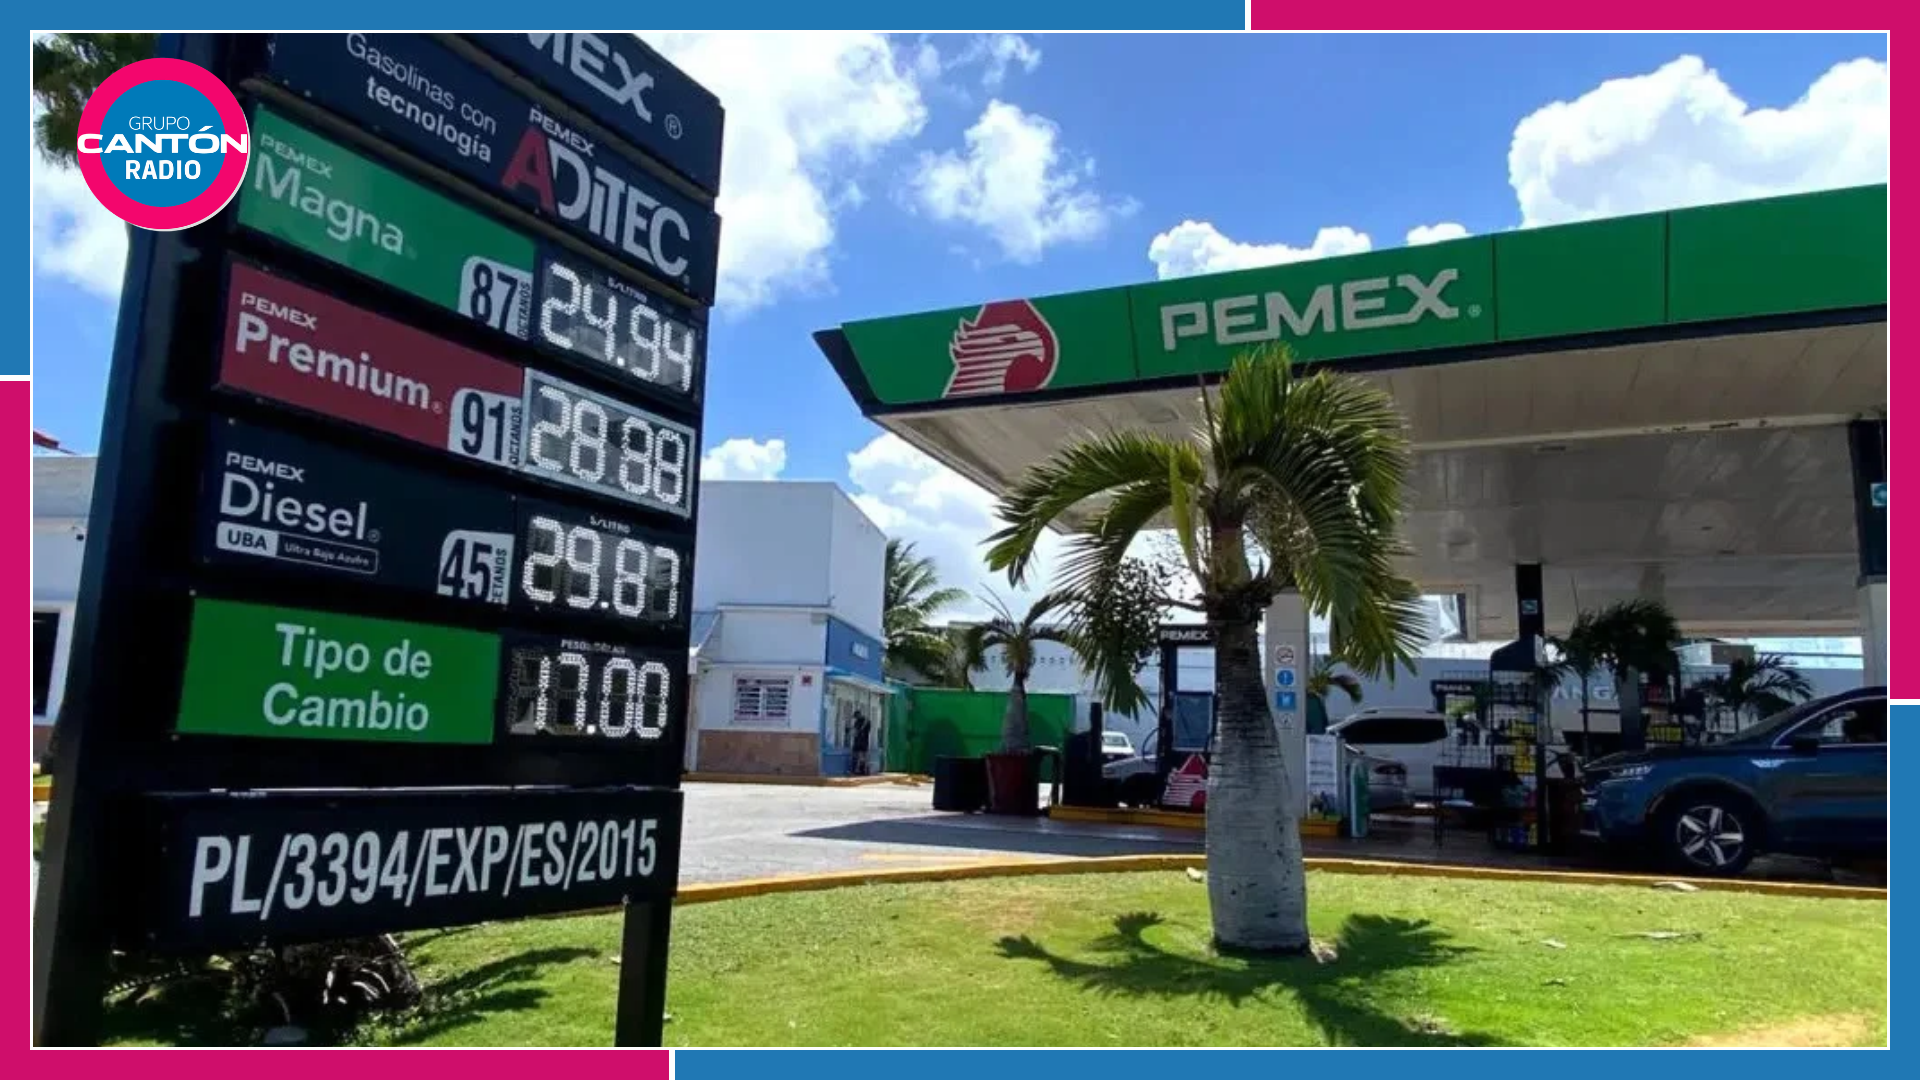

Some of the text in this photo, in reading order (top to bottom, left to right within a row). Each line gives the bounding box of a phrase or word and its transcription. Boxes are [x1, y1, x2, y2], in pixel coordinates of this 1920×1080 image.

[346, 33, 497, 136] Gasolinas con
[260, 133, 334, 179] PEMEX
[529, 107, 596, 157] PEMEX
[254, 151, 405, 256] Magna
[241, 292, 318, 331] PEMEX
[470, 262, 519, 336] 87
[540, 262, 694, 392] 24.94
[1160, 268, 1459, 350] PEMEX
[235, 311, 431, 410] Premium
[460, 392, 506, 461] 91
[508, 405, 523, 465] OCTANOS
[226, 451, 305, 482] PEMEX
[219, 471, 367, 540] Diesel
[226, 529, 268, 551] UBA
[284, 542, 312, 557] Ultra
[441, 538, 493, 600] 45
[522, 516, 680, 619] 29.87
[275, 622, 433, 680] Tipo de
[1160, 630, 1208, 641] PEMEX
[263, 682, 430, 732] Cambio
[534, 652, 671, 740] 17.00
[188, 818, 659, 920] PL/3394/EXP/ES/2015
